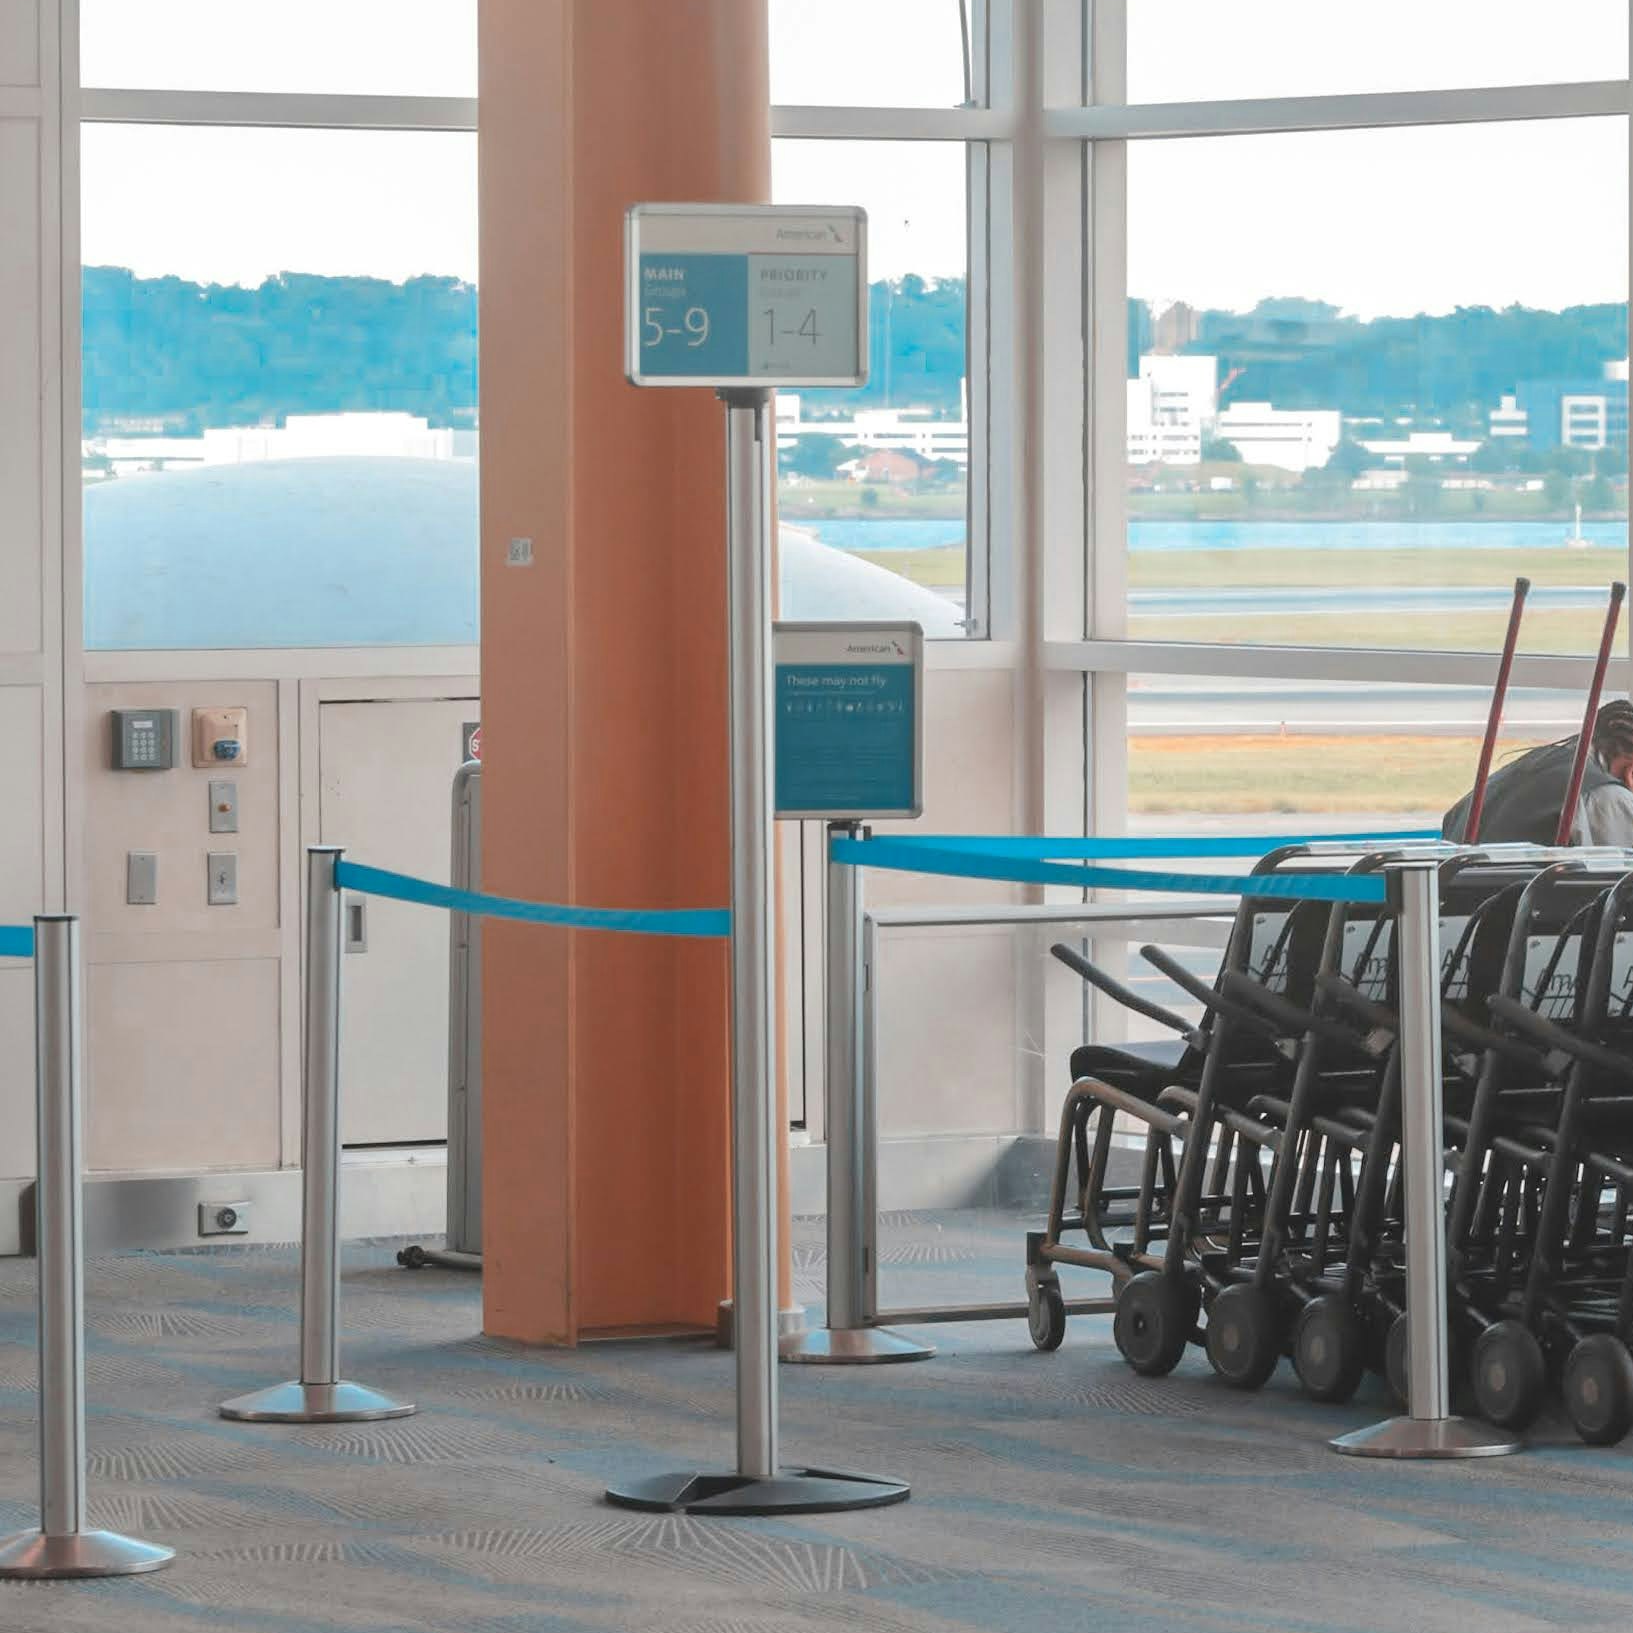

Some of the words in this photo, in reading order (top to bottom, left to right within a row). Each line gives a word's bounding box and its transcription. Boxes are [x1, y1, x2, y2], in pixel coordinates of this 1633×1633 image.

[775, 228, 827, 241] American
[643, 268, 685, 281] MAIN
[760, 269, 828, 281] PRIORITY
[846, 643, 892, 653] American
[786, 675, 819, 687] These
[822, 677, 846, 689] may
[849, 675, 869, 687] not
[871, 675, 887, 689] fly
